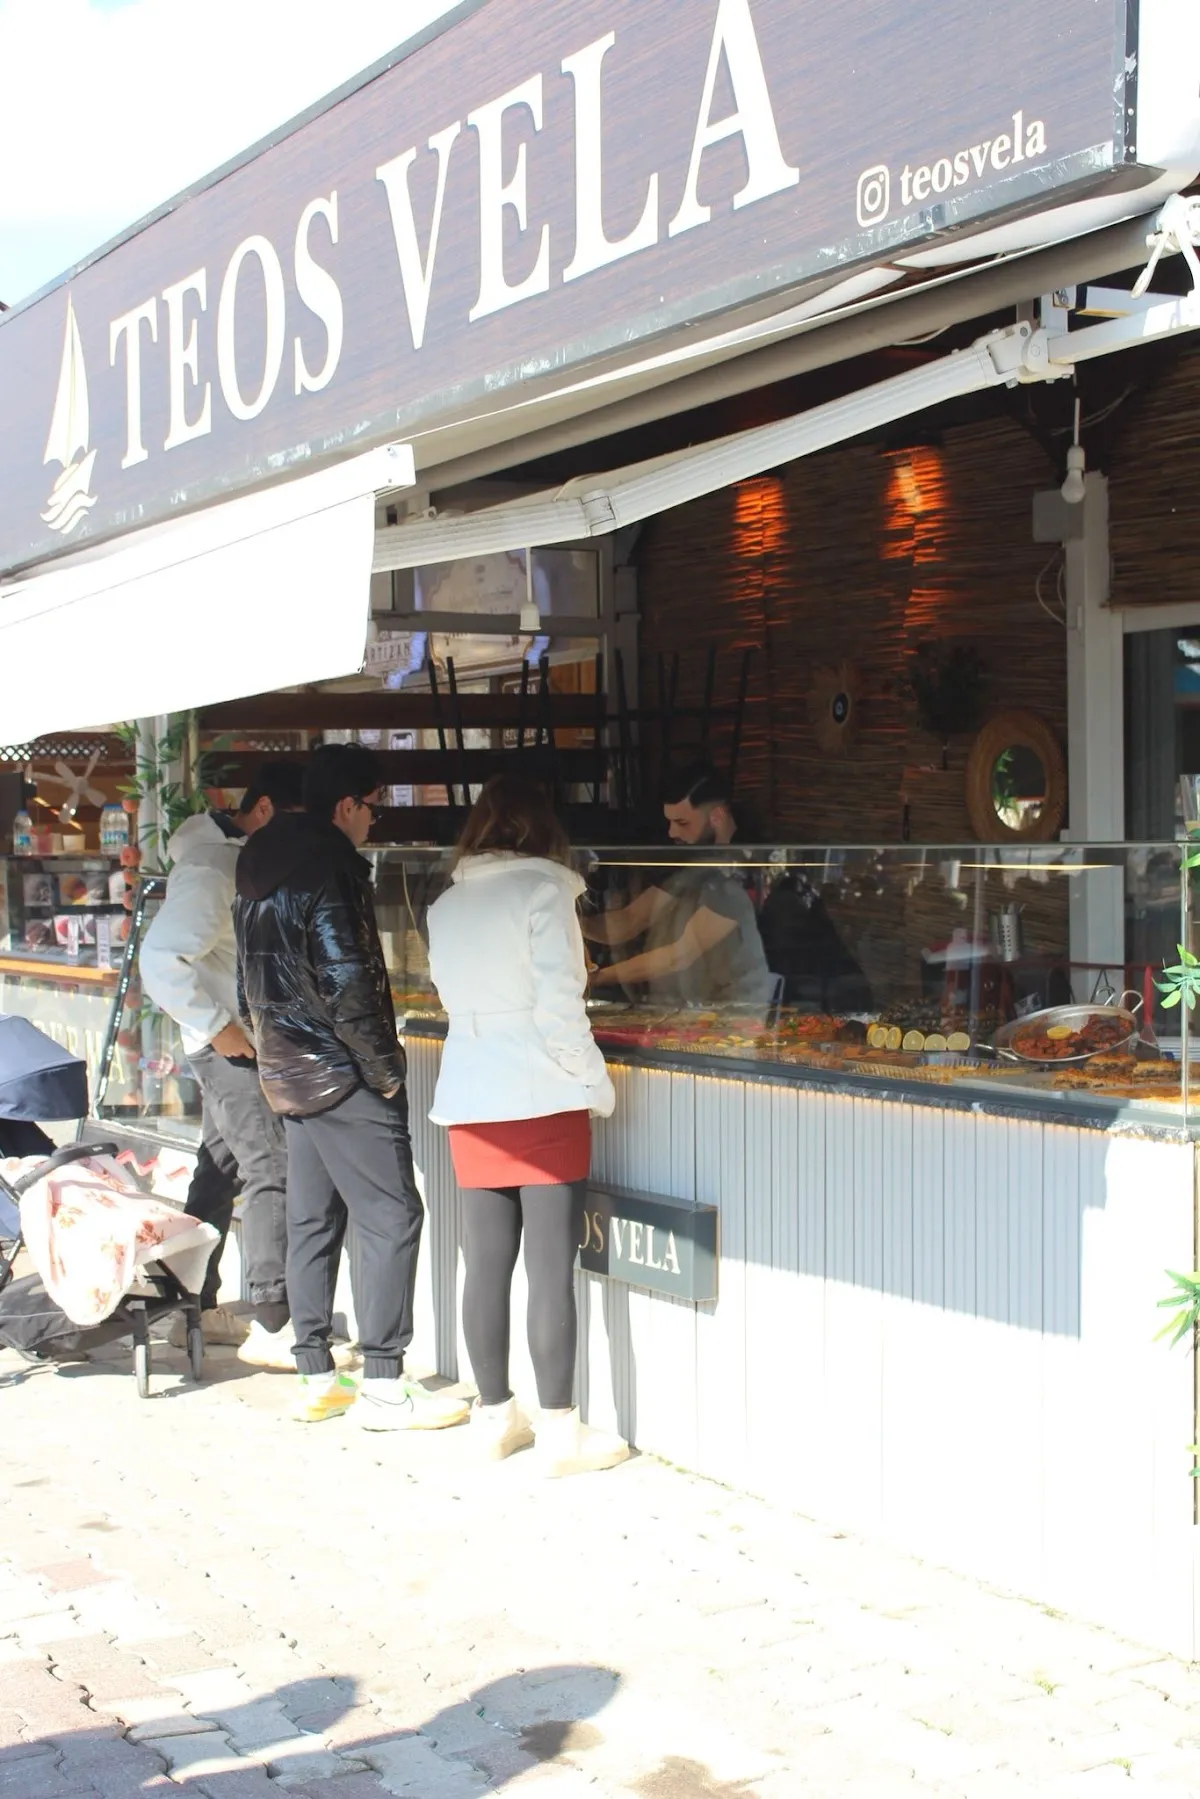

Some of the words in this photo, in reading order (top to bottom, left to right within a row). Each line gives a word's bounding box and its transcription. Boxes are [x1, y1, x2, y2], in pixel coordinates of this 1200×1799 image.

[900, 110, 1048, 206] teosvela
[110, 189, 344, 469] TEOS
[376, 0, 800, 351] VELA
[610, 1216, 681, 1275] VELA
